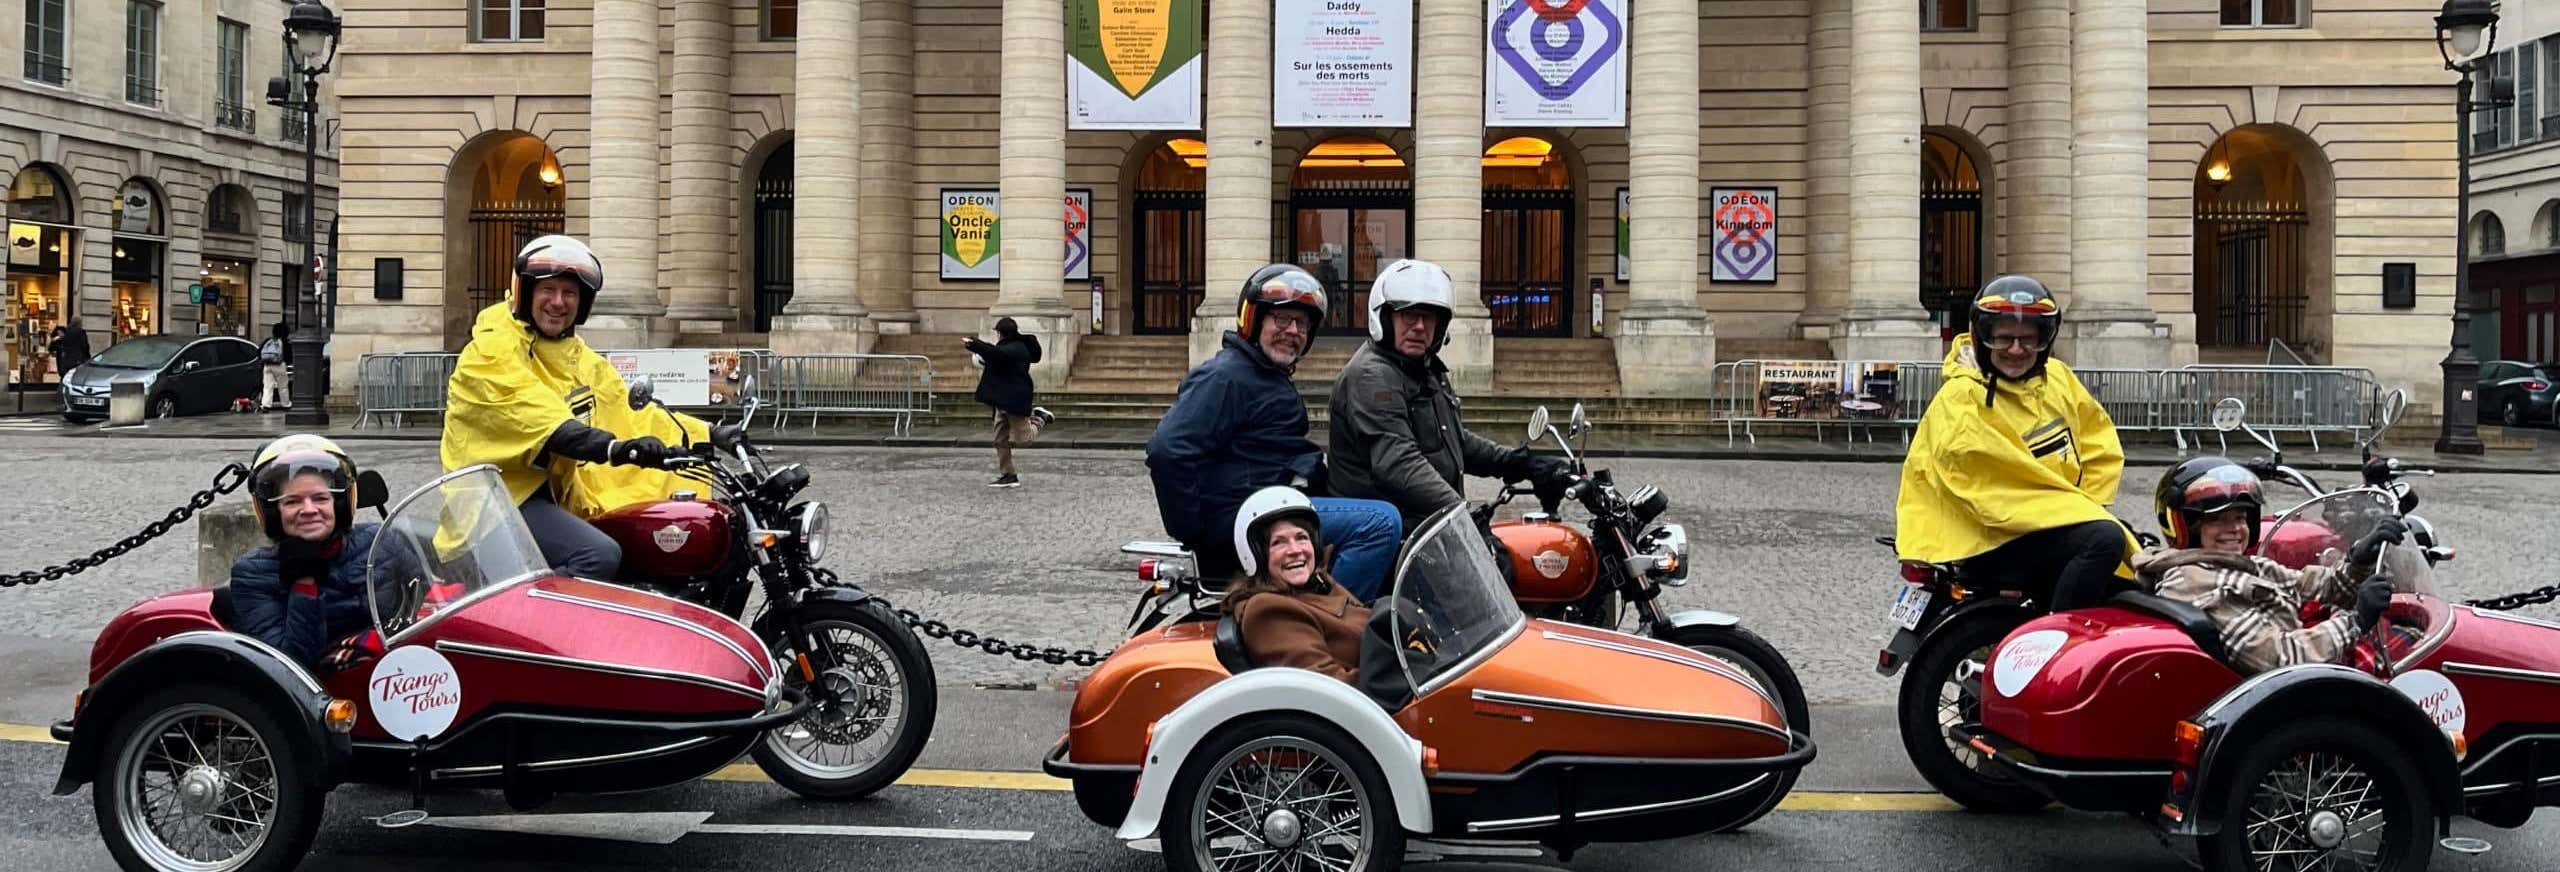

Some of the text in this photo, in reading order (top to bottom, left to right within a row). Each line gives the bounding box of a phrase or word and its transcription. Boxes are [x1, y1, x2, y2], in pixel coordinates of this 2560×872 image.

[1327, 2, 1361, 12] Daddy
[1326, 26, 1361, 36] Hedda
[1294, 61, 1393, 71] Sur les ossements
[1316, 71, 1370, 80] des morts
[950, 215, 993, 227] Oncle
[951, 227, 992, 240] Vania
[1764, 369, 1837, 379] RESTAURANT
[372, 671, 449, 702] Txango
[403, 691, 459, 715] Tours
